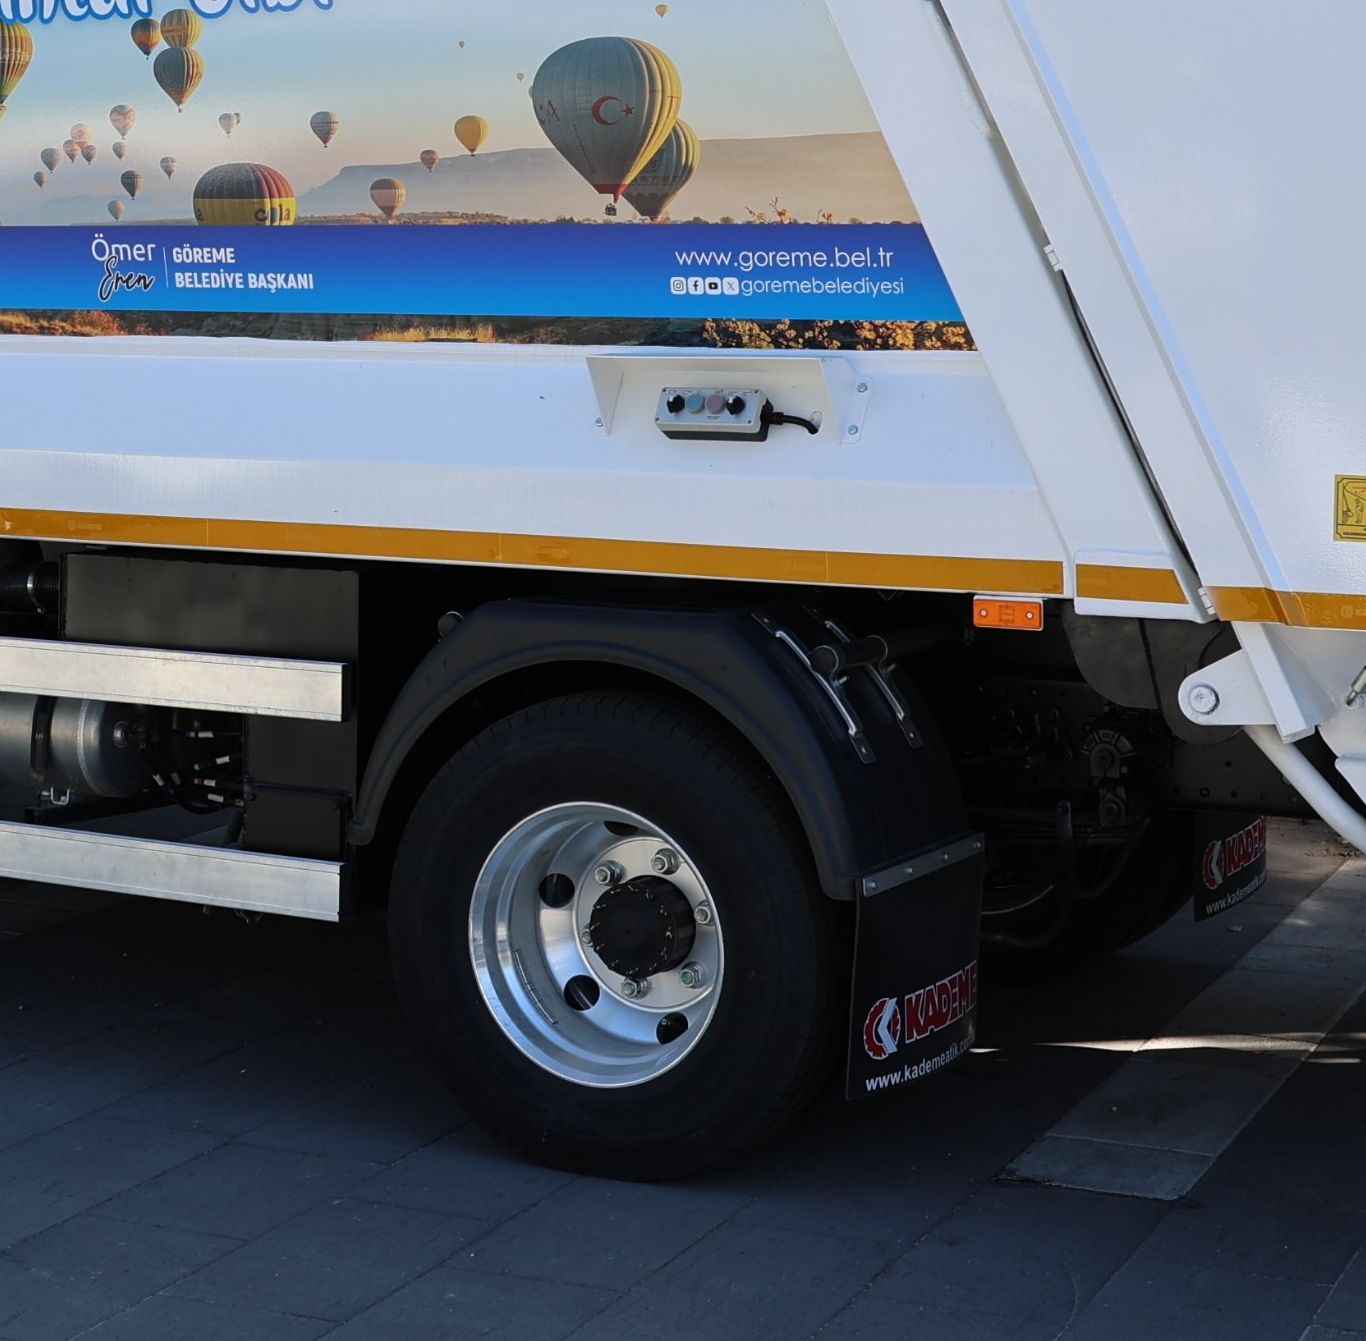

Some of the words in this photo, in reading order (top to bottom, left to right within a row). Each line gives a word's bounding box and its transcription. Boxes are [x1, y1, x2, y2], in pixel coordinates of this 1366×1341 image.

[91, 233, 156, 262] Ömer
[172, 244, 236, 264] GÖREME
[675, 247, 894, 272] www.goreme.bel.tr
[98, 255, 156, 303] Eren
[174, 269, 245, 289] BELEDİYE
[248, 273, 315, 293] BAŞKANI
[741, 276, 905, 298] goremebelediyesi
[904, 960, 977, 1044] KADEME
